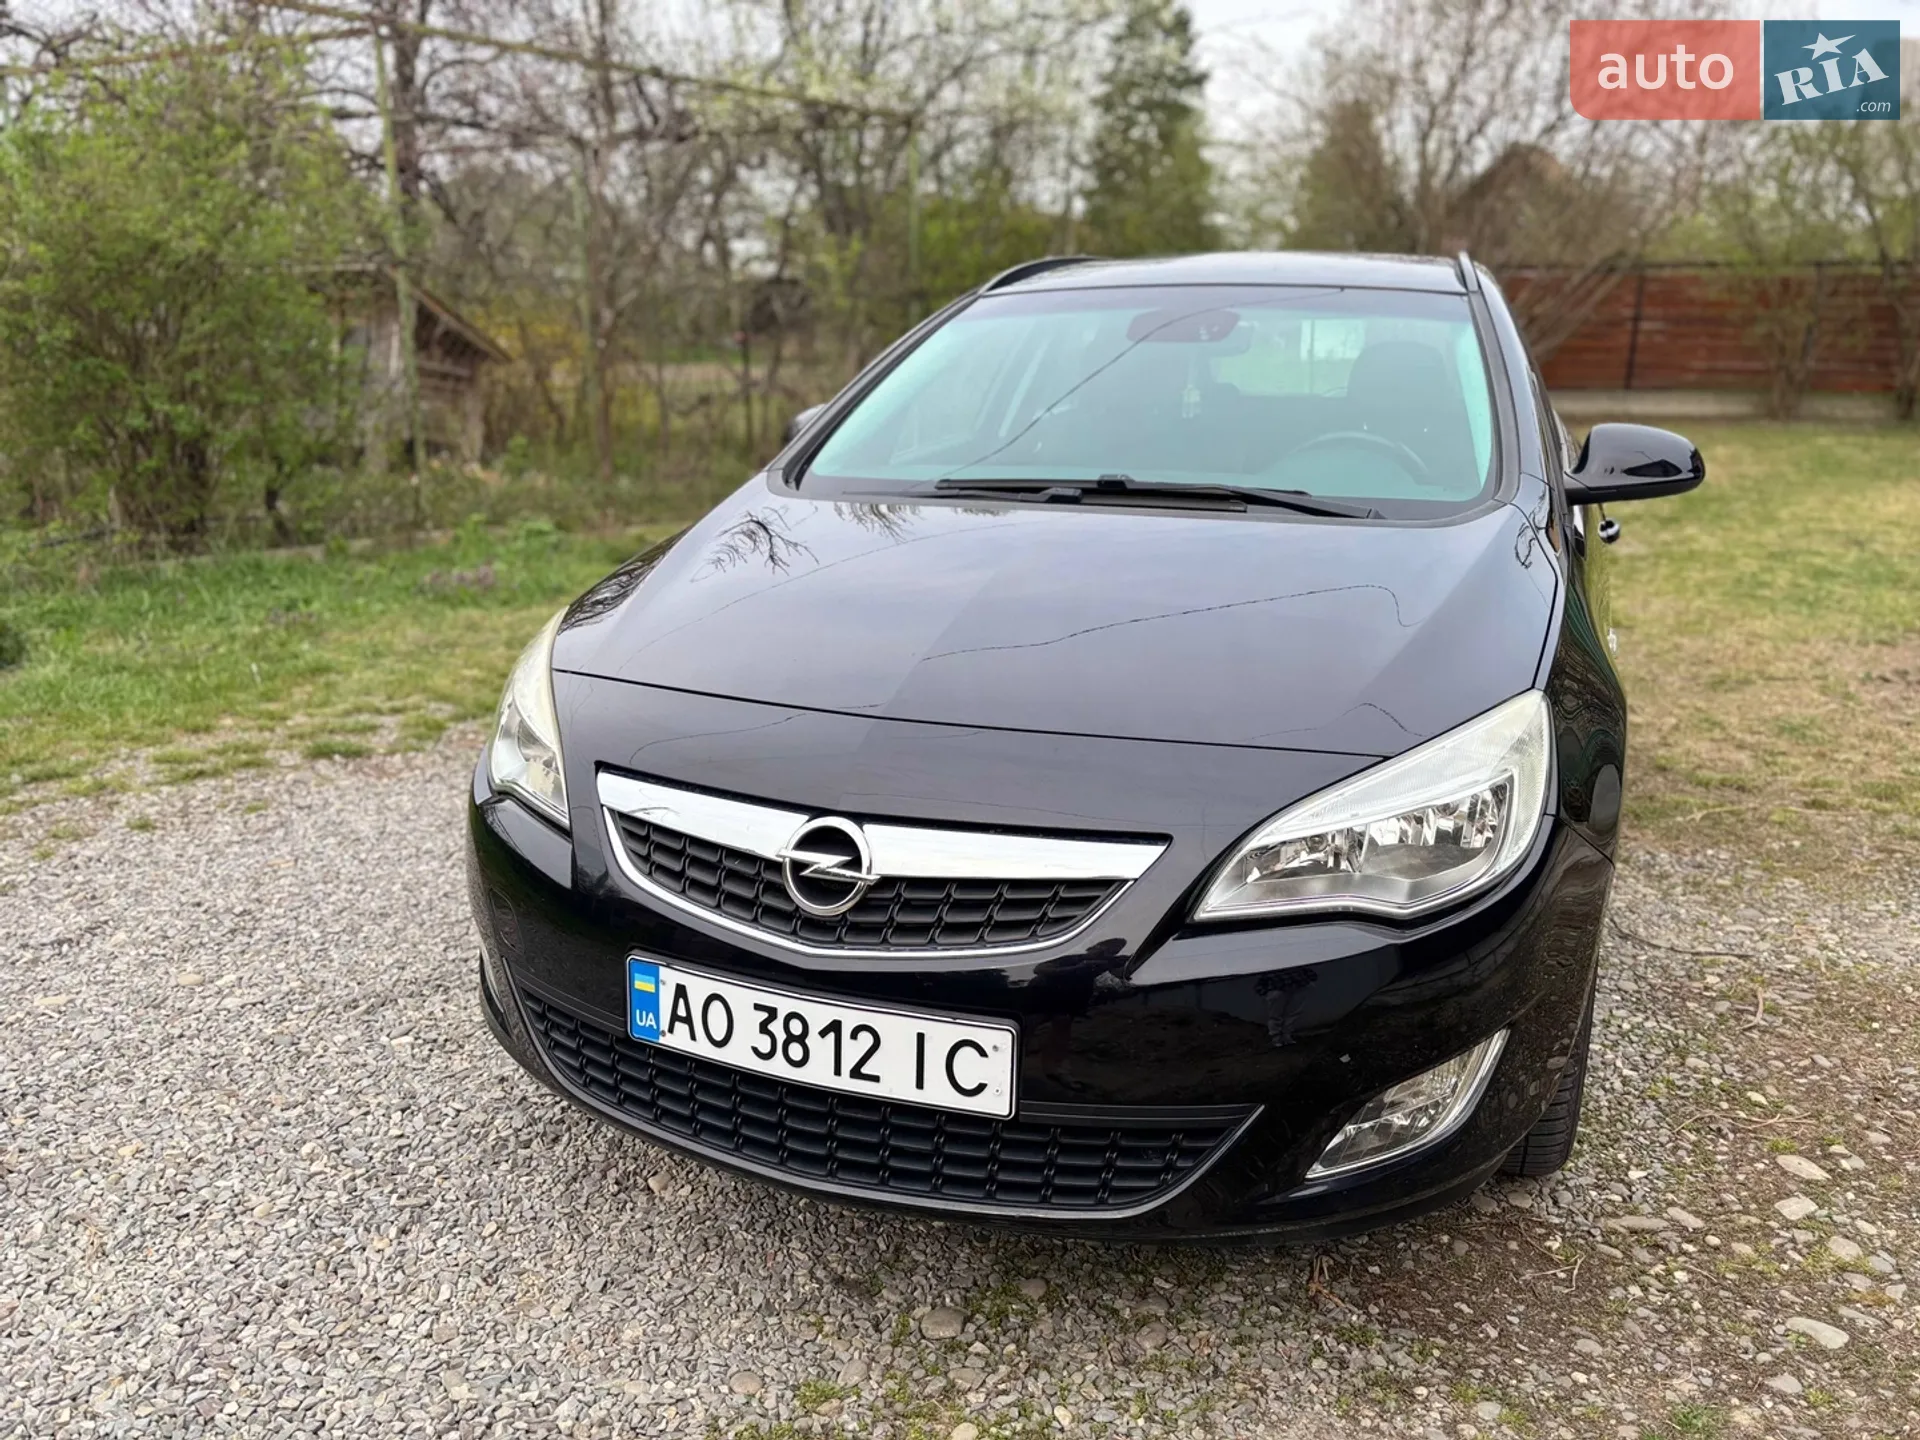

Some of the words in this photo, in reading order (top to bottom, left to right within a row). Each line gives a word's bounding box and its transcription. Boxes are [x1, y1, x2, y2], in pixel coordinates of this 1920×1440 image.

[636, 1009, 657, 1029] UA
[667, 983, 734, 1048] AO
[750, 1003, 881, 1083] 3812
[915, 1032, 989, 1097] IC
